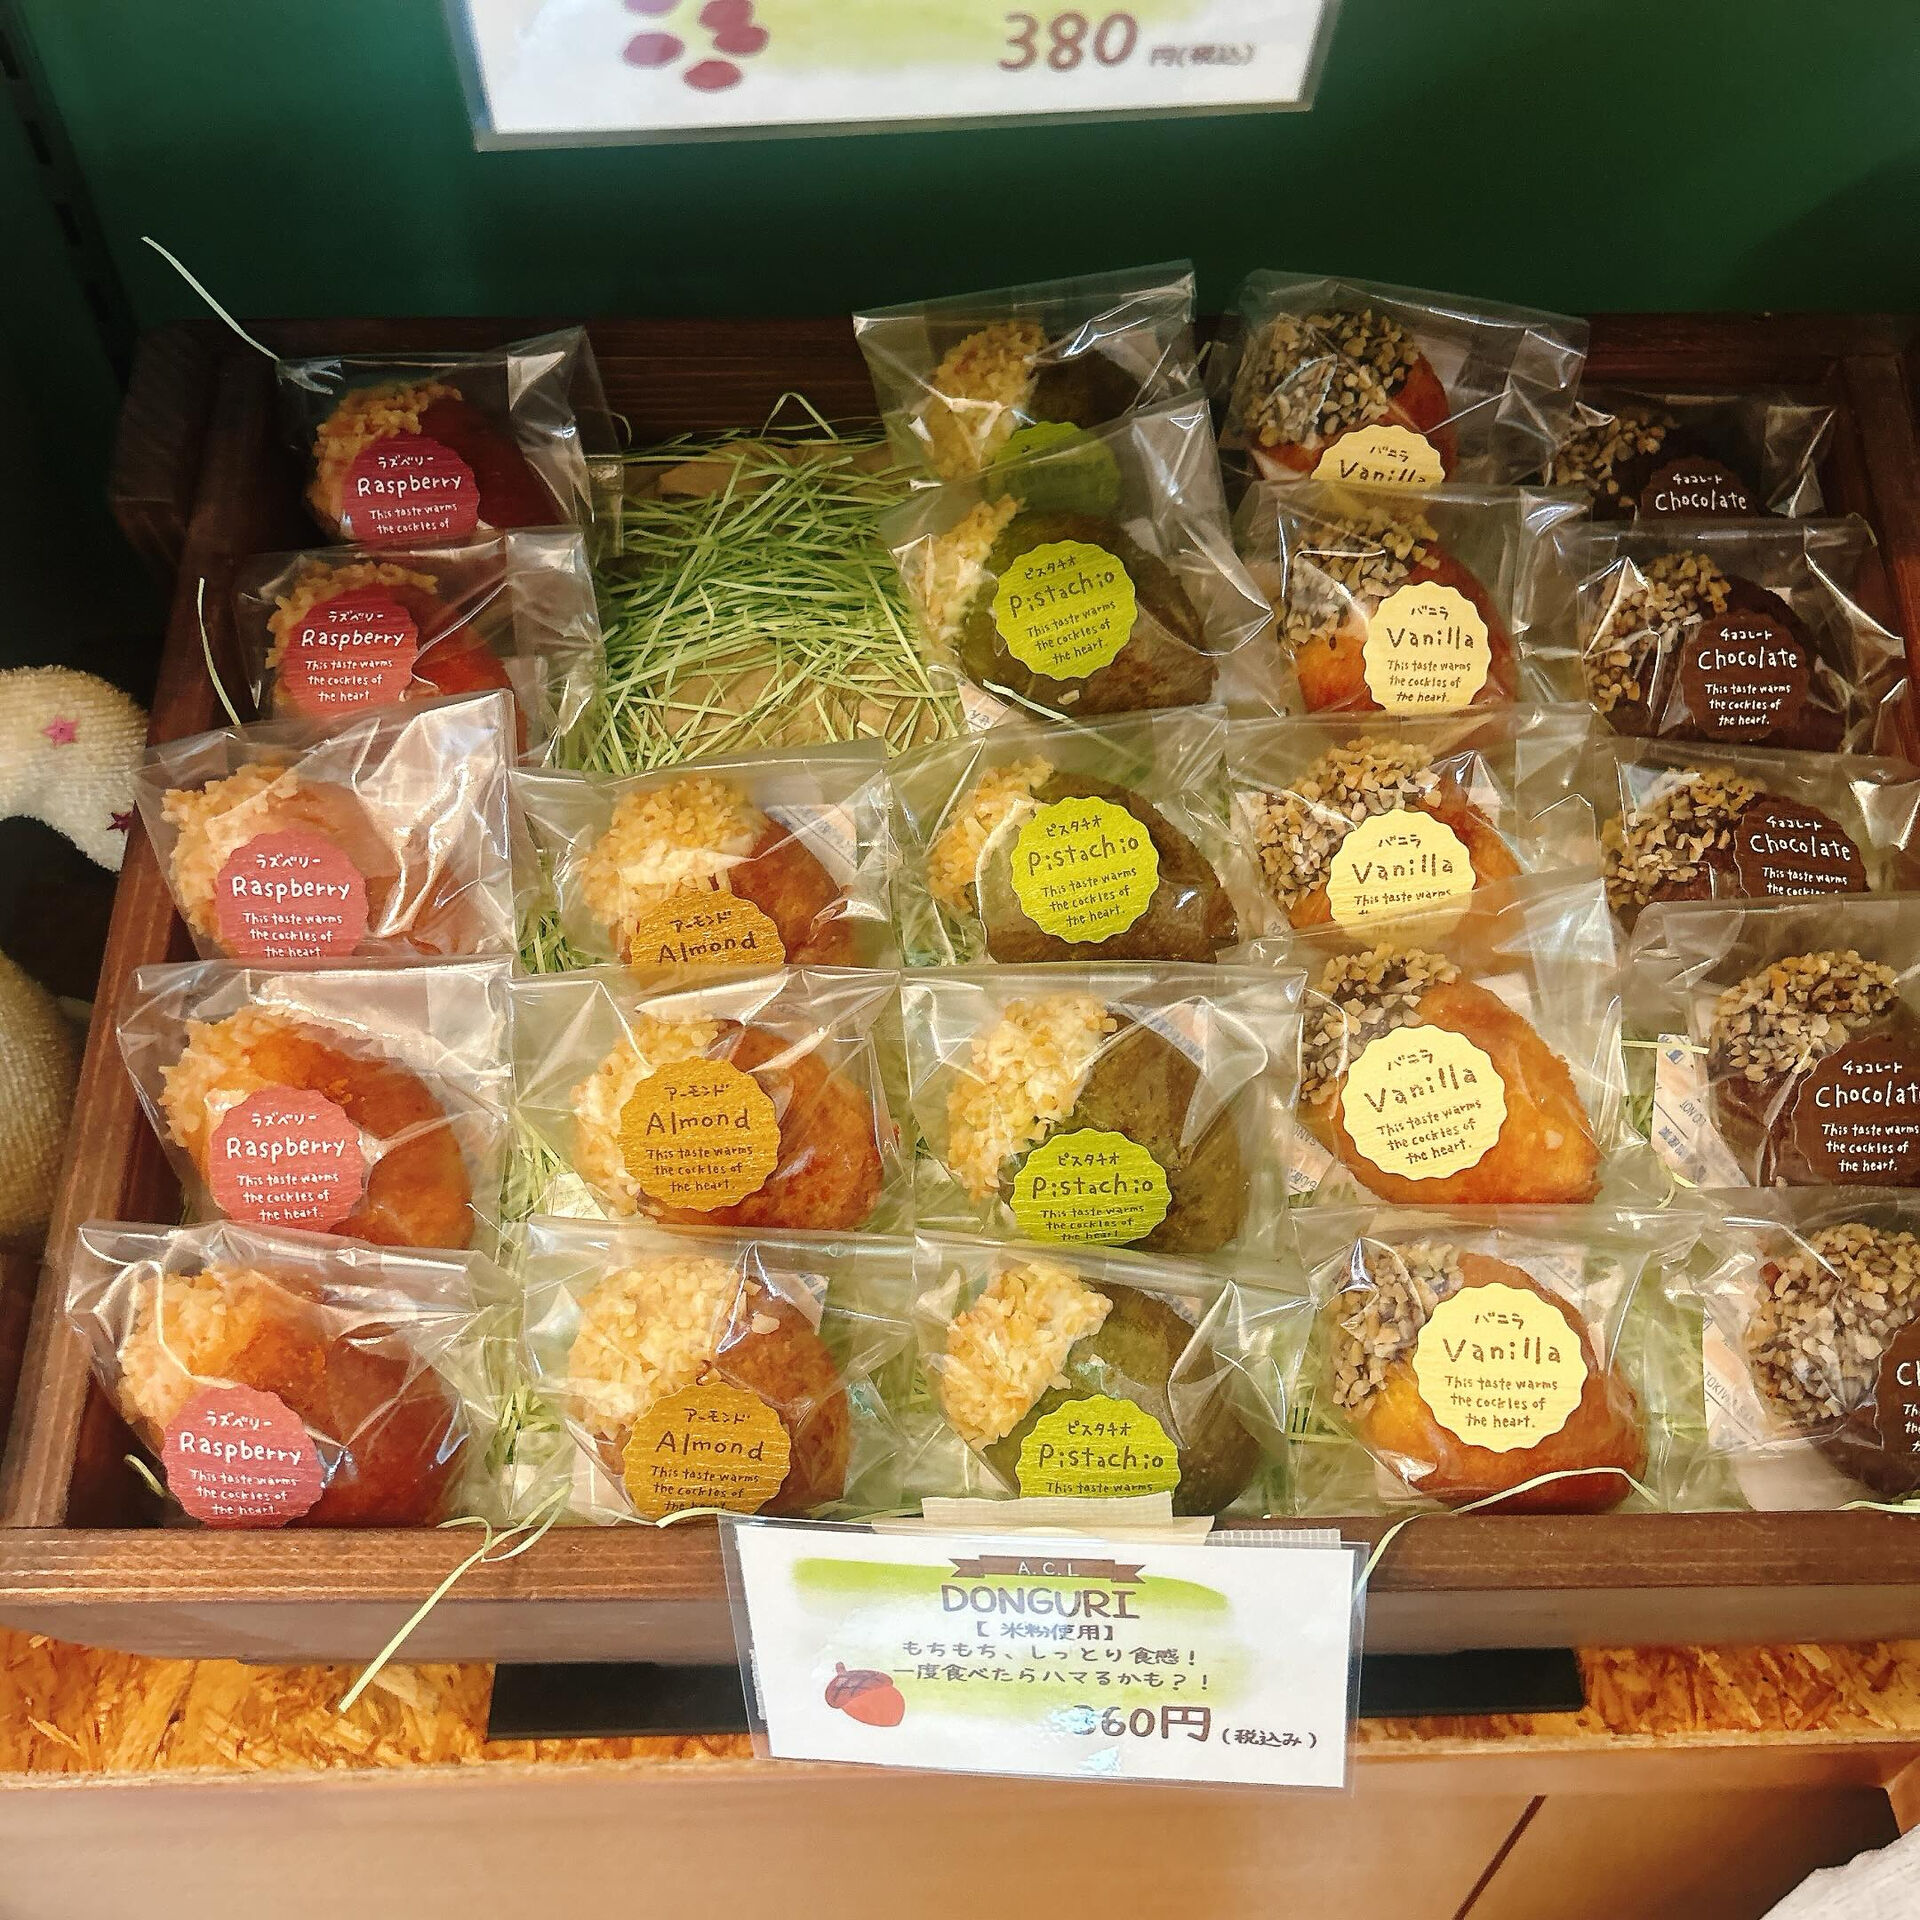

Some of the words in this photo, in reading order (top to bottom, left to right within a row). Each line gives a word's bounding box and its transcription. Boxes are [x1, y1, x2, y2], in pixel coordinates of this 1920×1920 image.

[999, 12, 1137, 72] 380
[378, 456, 434, 468] ラズベリー
[1370, 446, 1408, 462] バニラ
[357, 474, 462, 498] Raspberry
[1656, 489, 1747, 511] Chocolate
[1024, 555, 1076, 580] ピスタチオ
[1009, 571, 1115, 618] Pistachio
[328, 611, 384, 623] ラズベリー
[1027, 624, 1050, 638] This
[1052, 615, 1079, 631] taste
[1082, 601, 1116, 618] warms
[1411, 606, 1449, 620] バニラ
[302, 629, 404, 650] Raspberry
[1035, 640, 1054, 651] the
[1056, 626, 1097, 645] cockles
[1100, 619, 1111, 632] of
[1387, 626, 1473, 650] Vanilla
[1052, 652, 1071, 664] the
[1074, 639, 1108, 656] heart.
[1698, 647, 1798, 670] Chocolate
[306, 659, 328, 670] This
[330, 659, 356, 670] taste
[359, 658, 392, 669] warms
[1388, 660, 1409, 671] This
[1412, 661, 1437, 671] taste
[1441, 662, 1471, 671] warms
[1389, 675, 1405, 686] the
[1408, 675, 1447, 688] cockles
[1450, 677, 1461, 688] of
[1705, 684, 1728, 694] This
[1731, 684, 1756, 695] taste
[1760, 684, 1791, 694] warms
[1397, 692, 1414, 702] the
[1709, 699, 1725, 709] the
[1729, 700, 1767, 710] cockles
[1770, 699, 1781, 710] of
[1718, 714, 1734, 726] the
[1738, 715, 1769, 726] heart.
[1046, 815, 1102, 837] ピスタチオ
[1378, 834, 1421, 848] バニラ
[1750, 834, 1850, 861] Chocolate
[256, 854, 320, 868] ラズベリー
[1028, 835, 1139, 876] Pistachio
[1352, 854, 1453, 884] Vanilla
[1762, 867, 1784, 879] This
[1787, 869, 1813, 883] taste
[1816, 874, 1847, 885] warms
[231, 876, 350, 903] Raspberry
[1041, 885, 1066, 898] This
[1069, 878, 1098, 893] taste
[1101, 868, 1137, 884] warms
[1049, 900, 1069, 912] the
[1072, 891, 1115, 908] cockles
[1119, 885, 1130, 897] of
[242, 912, 268, 924] This
[271, 913, 302, 925] taste
[305, 914, 342, 924] warms
[670, 910, 731, 933] アーモンド
[1066, 914, 1085, 927] the
[1089, 905, 1126, 922] heart.
[250, 929, 268, 940] the
[272, 929, 317, 941] cockles
[320, 931, 333, 942] of
[659, 931, 758, 963] Almond
[1388, 1049, 1433, 1071] バニラ
[665, 1084, 730, 1101] アーモンド
[1364, 1064, 1477, 1112] Vanilla
[1816, 1081, 1920, 1108] Chocolat
[252, 1112, 318, 1127] ラズベリー
[646, 1108, 750, 1135] Almond
[1376, 1124, 1404, 1137] This
[1407, 1112, 1439, 1130] taste
[1443, 1100, 1482, 1119] warms
[1387, 1138, 1408, 1151] the
[1412, 1125, 1459, 1145] cockles
[1464, 1118, 1476, 1130] of
[1822, 1124, 1847, 1136] This
[1852, 1124, 1881, 1136] taste
[1885, 1124, 1919, 1135] warms
[226, 1137, 345, 1164] Raspberry
[646, 1149, 674, 1161] This
[677, 1148, 710, 1159] taste
[714, 1146, 753, 1157] warms
[1406, 1151, 1428, 1164] the
[1431, 1138, 1472, 1159] heart.
[1826, 1140, 1845, 1153] the
[1849, 1141, 1893, 1154] cockles
[1897, 1141, 1909, 1153] of
[1058, 1152, 1120, 1166] ピスタチオ
[1839, 1159, 1859, 1172] the
[1863, 1159, 1897, 1172] heart.
[653, 1166, 673, 1175] the
[678, 1164, 726, 1175] cockles
[730, 1163, 743, 1173] of
[237, 1174, 263, 1187] This
[267, 1174, 297, 1186] taste
[300, 1173, 339, 1184] warms
[669, 1182, 690, 1192] the
[695, 1179, 735, 1192] heart.
[1033, 1173, 1153, 1199] Pistachio
[243, 1191, 263, 1203] the
[267, 1191, 314, 1202] cockles
[317, 1190, 330, 1201] of
[260, 1210, 279, 1221] the
[1040, 1209, 1066, 1219] This
[1070, 1208, 1102, 1218] taste
[1106, 1205, 1144, 1215] warms
[1046, 1222, 1066, 1230] the
[1070, 1220, 1117, 1229] cockles
[1121, 1218, 1133, 1226] of
[1475, 1312, 1523, 1329] バニラ
[1443, 1337, 1560, 1364] Vanilla
[1445, 1376, 1472, 1389] This
[1477, 1377, 1511, 1390] taste
[1516, 1380, 1557, 1390] warms
[1451, 1393, 1471, 1405] the
[1476, 1396, 1527, 1410] cockles
[1532, 1398, 1546, 1410] of
[204, 1410, 272, 1430] ラズベリー
[684, 1408, 750, 1424] アーモンド
[1466, 1414, 1486, 1427] the
[1493, 1415, 1536, 1428] heart.
[1068, 1419, 1131, 1436] ピスタチオ
[179, 1432, 301, 1465] Raspberry
[655, 1431, 764, 1461] Almond
[1039, 1444, 1163, 1470] Pistachio
[651, 1465, 678, 1477] This
[683, 1469, 715, 1481] taste
[719, 1473, 759, 1483] warms
[653, 1483, 673, 1495] the
[678, 1485, 726, 1497] cockles
[731, 1488, 744, 1498] of
[1046, 1482, 1072, 1493] This
[1077, 1483, 1109, 1493] taste
[1113, 1483, 1153, 1492] warms
[941, 1584, 1141, 1619] DONGURI
